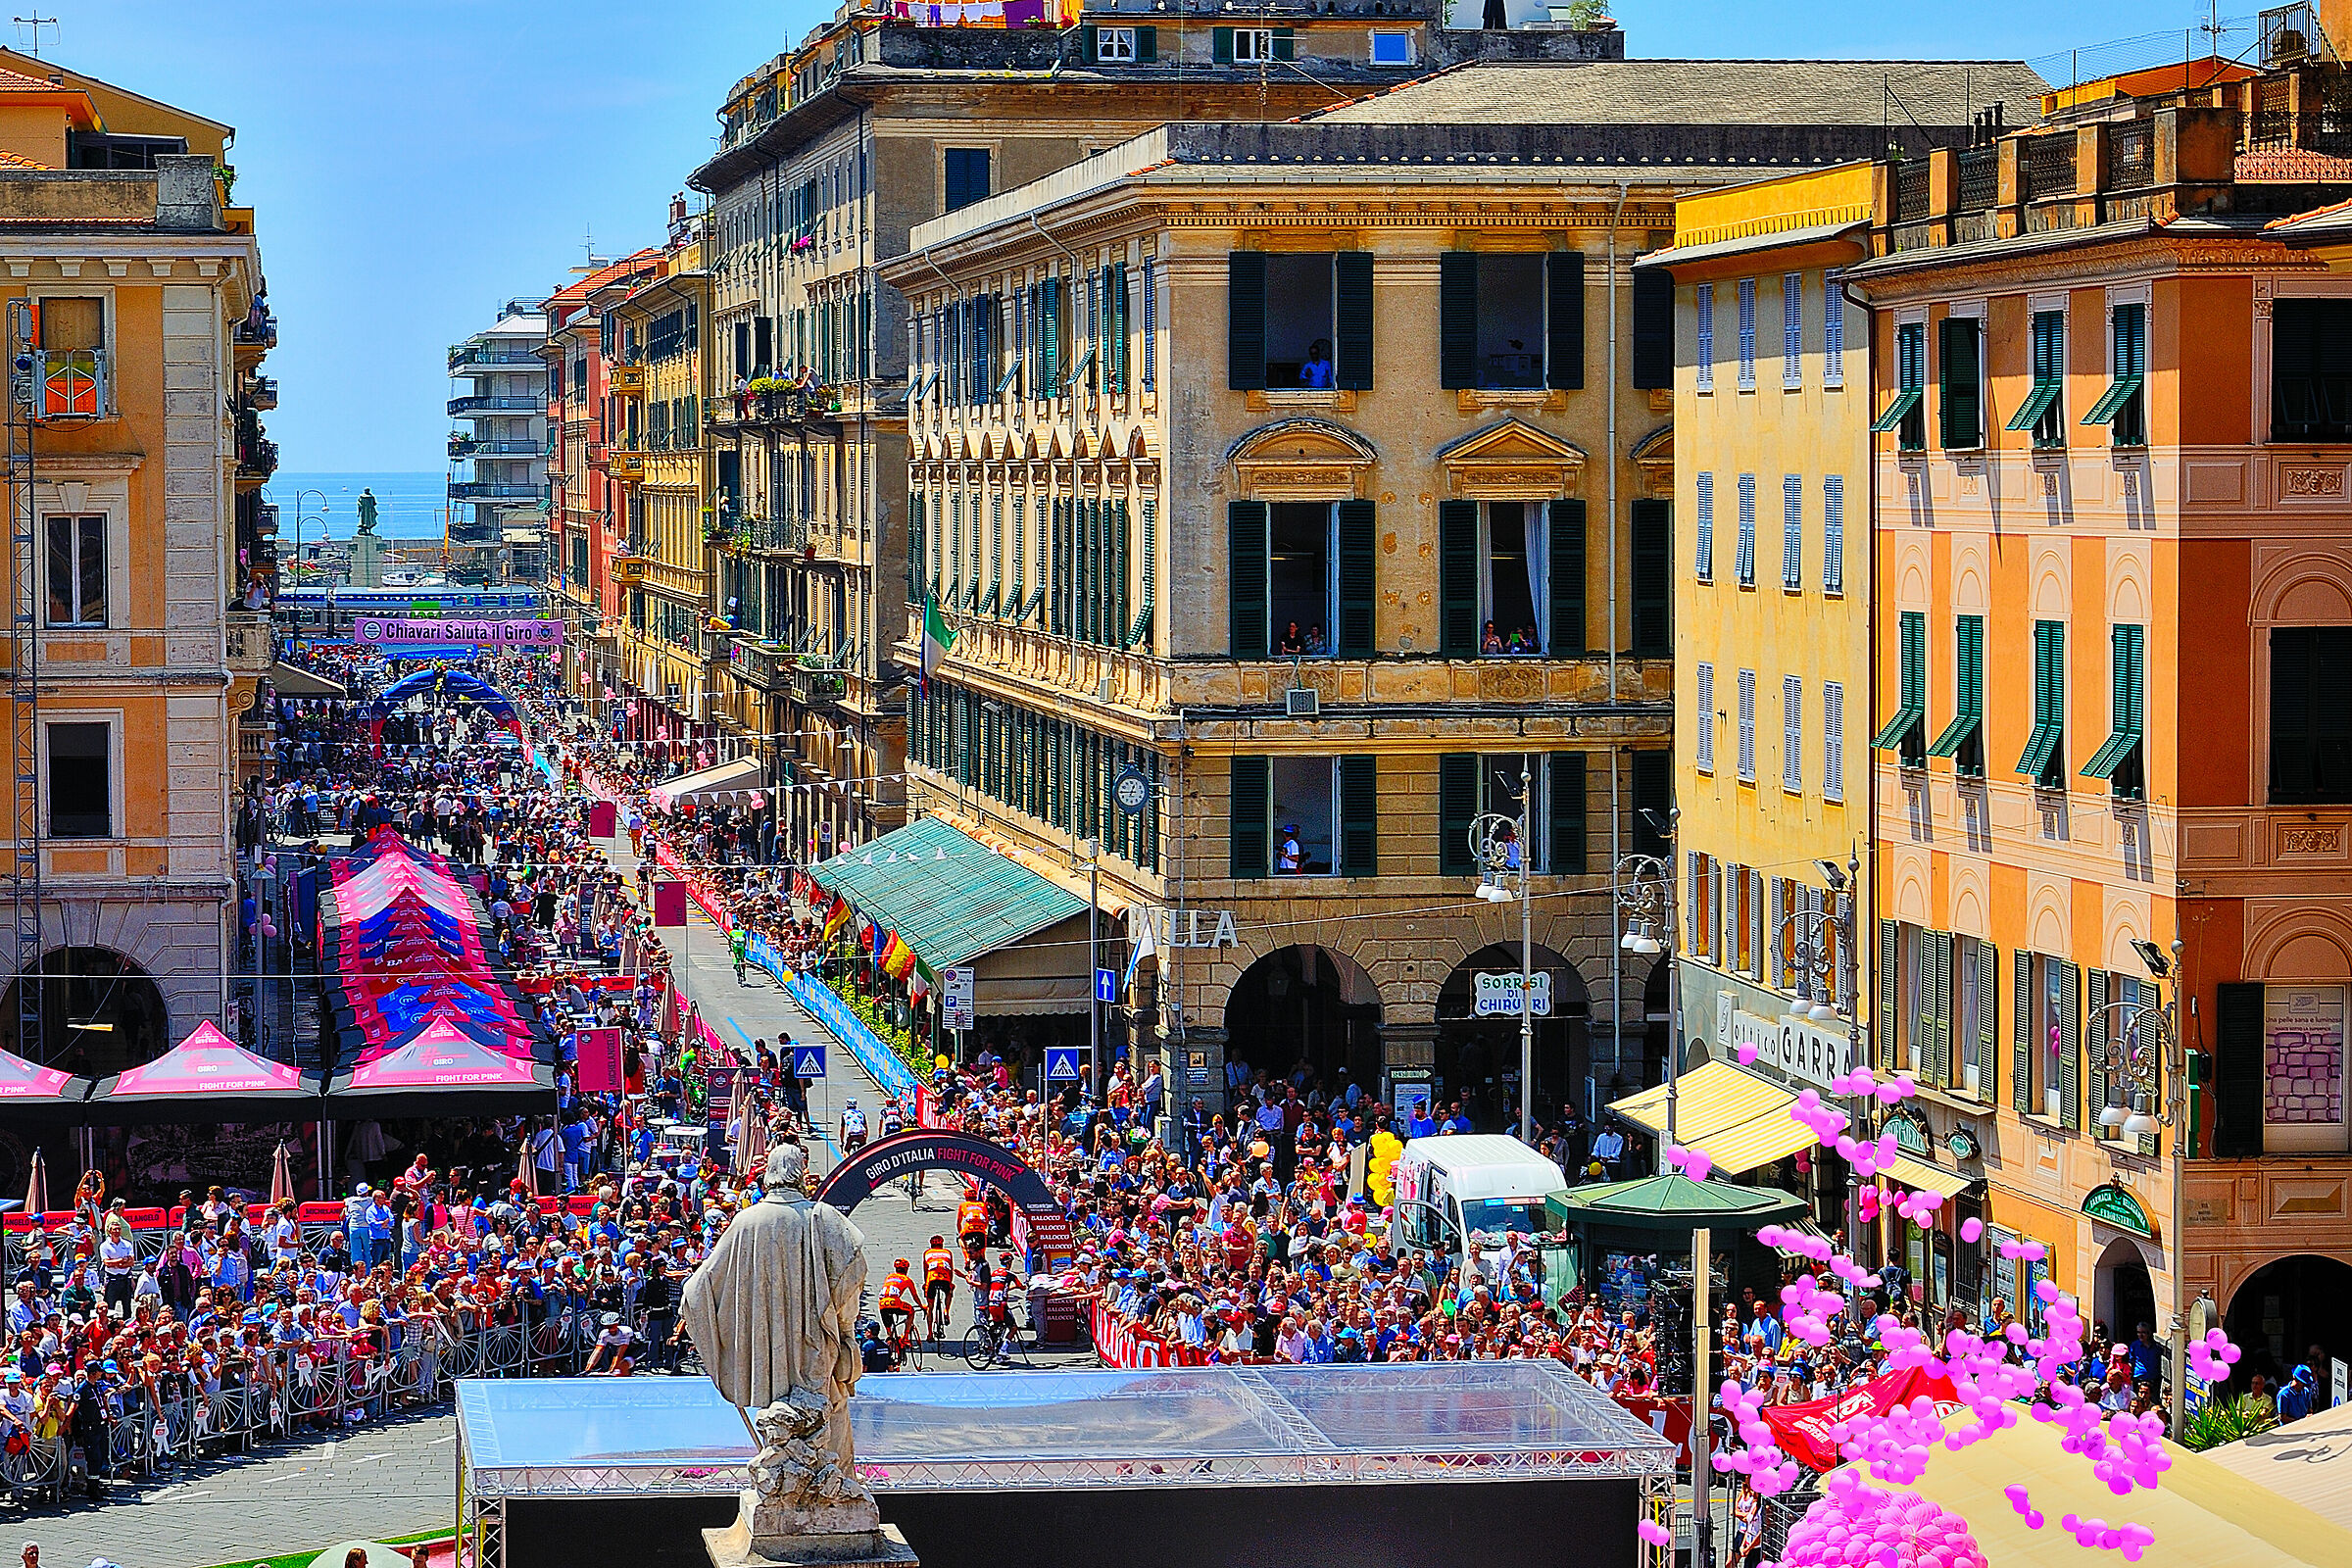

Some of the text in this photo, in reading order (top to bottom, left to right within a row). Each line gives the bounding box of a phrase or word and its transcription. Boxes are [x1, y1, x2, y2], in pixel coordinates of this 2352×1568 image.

[386, 622, 441, 640] Chiavari
[444, 622, 488, 640] Saluta
[491, 622, 500, 640] il
[504, 624, 533, 641] Giro
[1482, 977, 1544, 989] SORRSI
[1479, 999, 1545, 1010] CHIAVRI
[433, 1057, 454, 1066] GIRO
[865, 1148, 1016, 1183] GIRO D'ITALIA FIGHT FOR PINK
